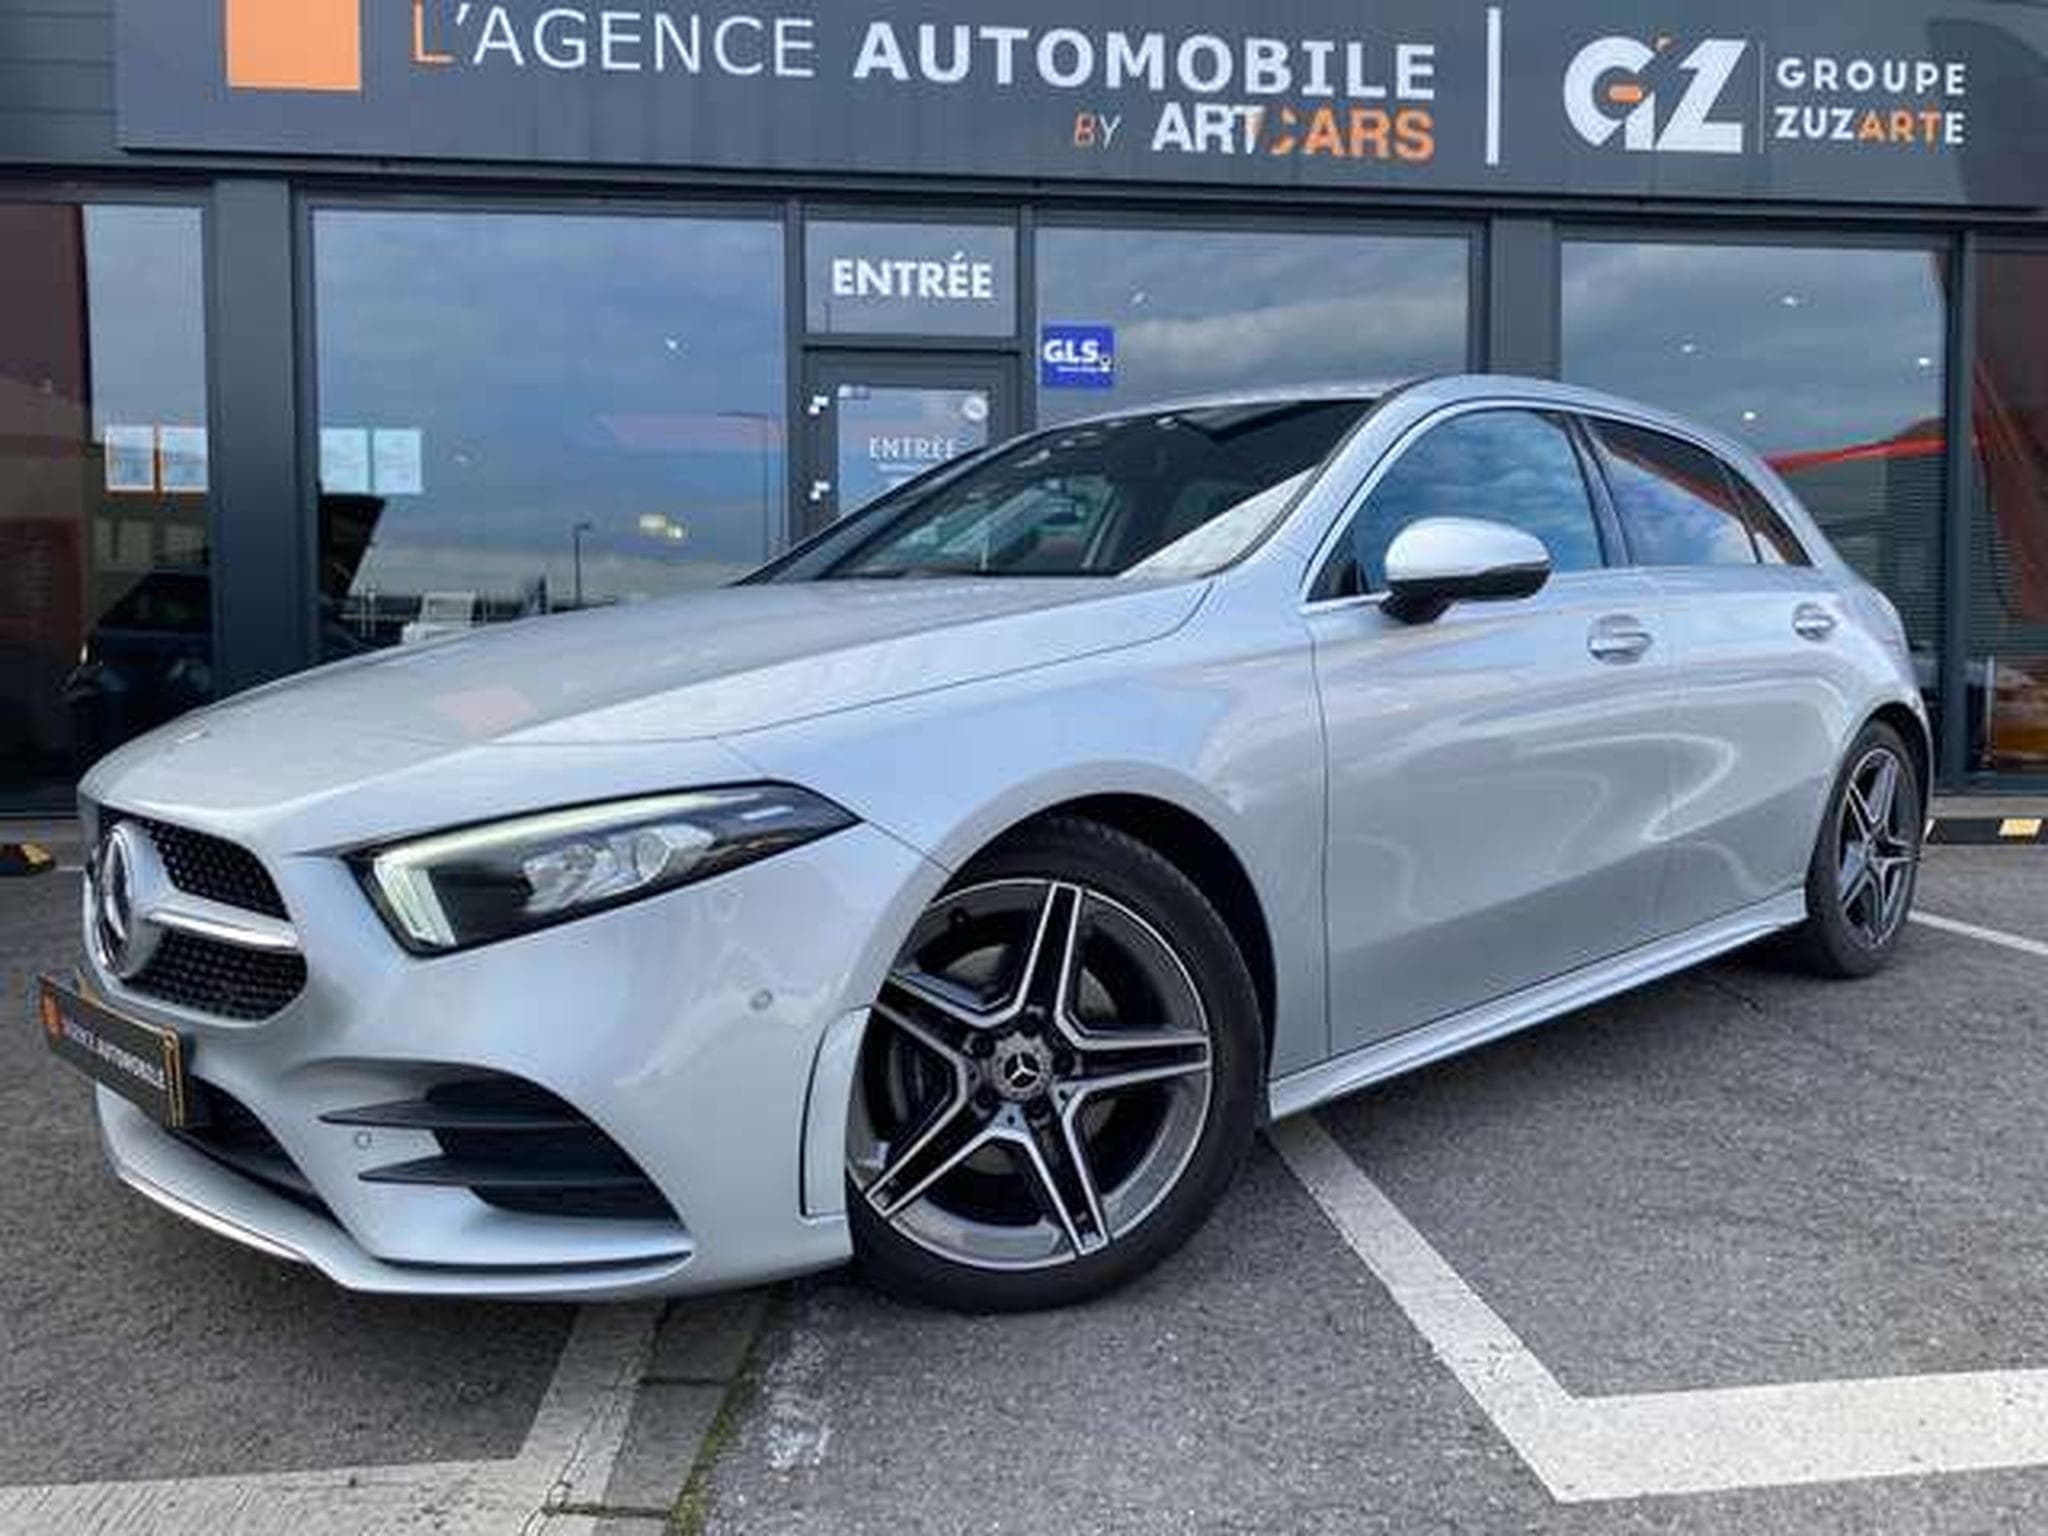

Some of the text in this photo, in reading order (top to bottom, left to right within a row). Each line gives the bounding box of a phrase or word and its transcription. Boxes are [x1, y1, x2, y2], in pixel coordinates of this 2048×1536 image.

[410, 0, 1436, 101] L'AGENCE AUTOMOBILE
[1775, 57, 1966, 96] GROUPE
[1073, 111, 1121, 148] BY
[1774, 106, 1966, 146] ZUZARTE
[832, 251, 993, 300] ENTRÉE
